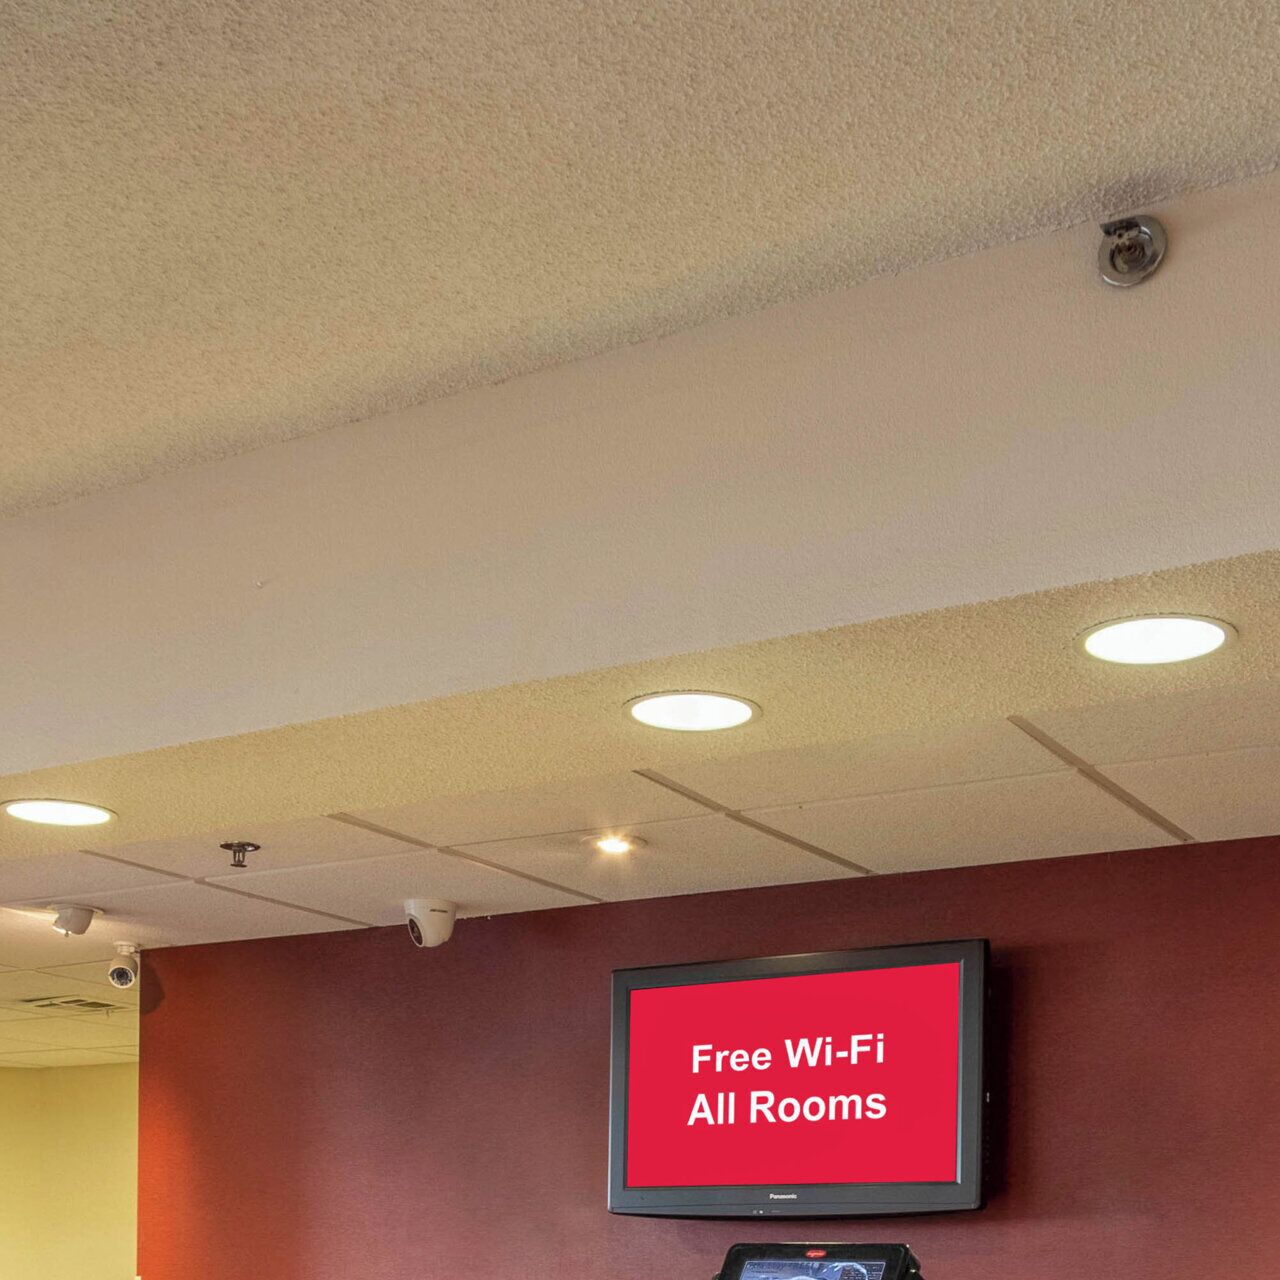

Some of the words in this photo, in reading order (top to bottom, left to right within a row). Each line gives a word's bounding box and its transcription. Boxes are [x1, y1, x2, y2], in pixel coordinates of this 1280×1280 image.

[692, 1043, 772, 1074] Free
[784, 1033, 885, 1069] Wi-Fi
[687, 1091, 736, 1126] All
[749, 1090, 887, 1124] Rooms
